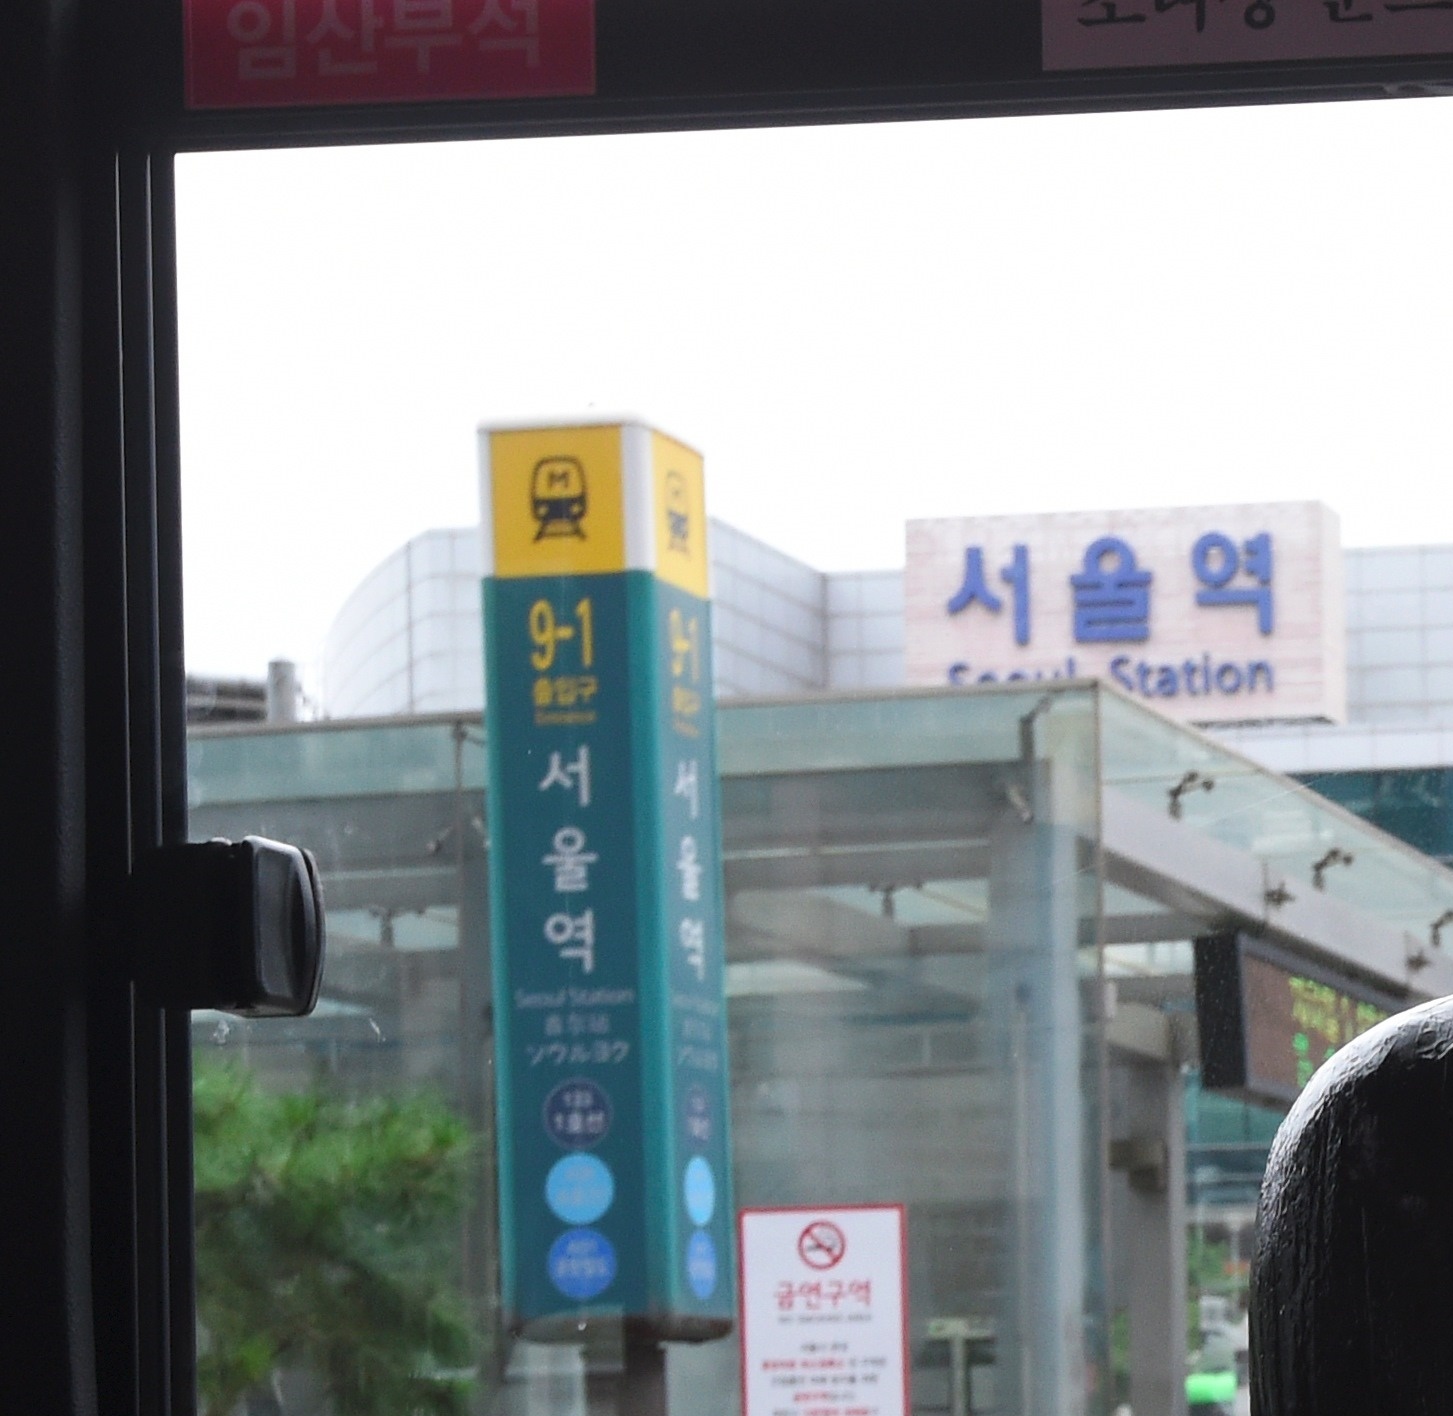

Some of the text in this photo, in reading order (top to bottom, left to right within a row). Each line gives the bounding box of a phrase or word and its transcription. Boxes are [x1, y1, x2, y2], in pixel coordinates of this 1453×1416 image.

[529, 599, 594, 671] 9-1
[947, 531, 1275, 646] 서울역
[1109, 653, 1275, 698] Station
[538, 744, 599, 974] 서울역
